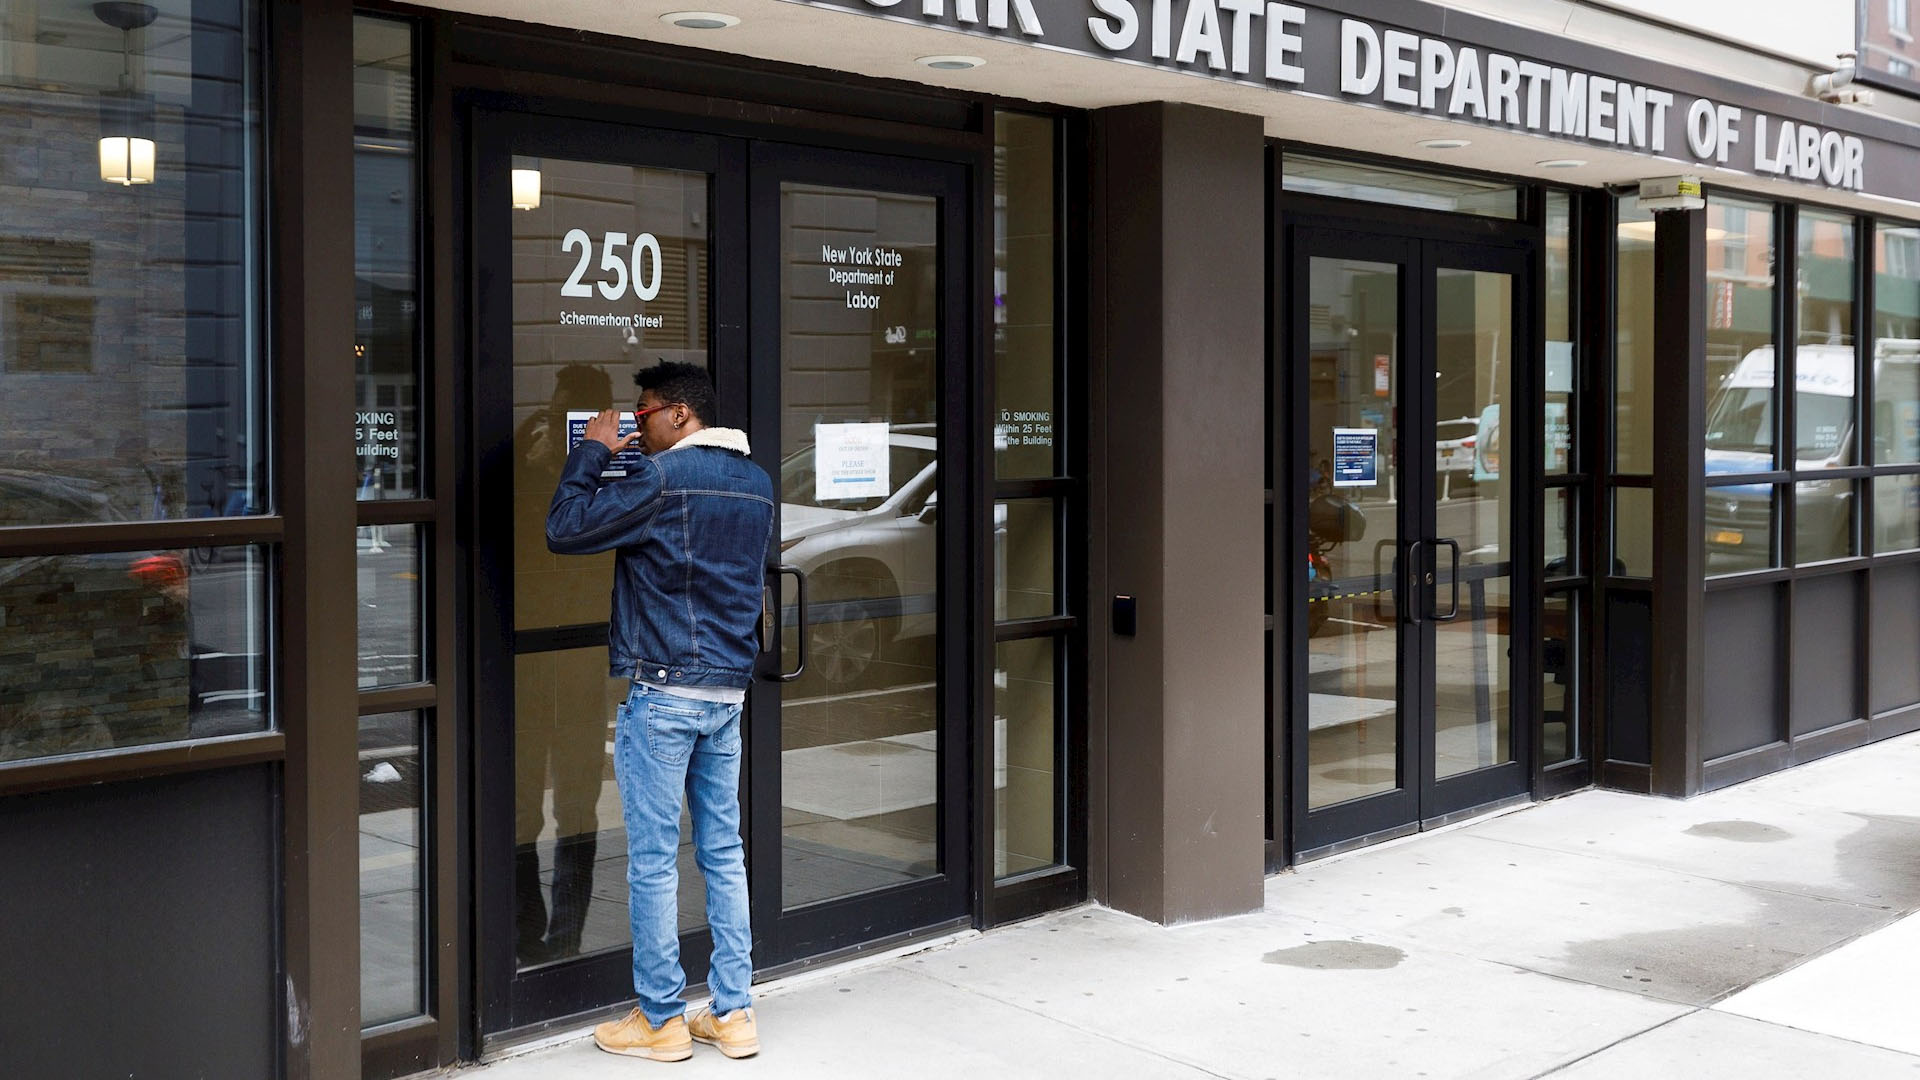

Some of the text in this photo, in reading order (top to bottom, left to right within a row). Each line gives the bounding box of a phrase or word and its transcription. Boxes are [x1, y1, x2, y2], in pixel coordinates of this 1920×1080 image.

[1087, 0, 1305, 84] STATE
[1340, 18, 1674, 152] DEPARTMENT
[1687, 98, 1741, 163] OF
[1754, 114, 1864, 190] LABOR
[822, 245, 902, 267] New York State
[560, 228, 662, 301] 250
[829, 267, 894, 287] Department of
[846, 290, 880, 309] Labor
[560, 311, 663, 328] Schermerhorn Street
[355, 412, 394, 425] OKING
[1013, 411, 1050, 421] SMOKING
[355, 428, 399, 440] 5 Feet
[995, 424, 1053, 433] Within 25 Feet
[1007, 436, 1020, 445] the
[1022, 436, 1053, 446] Building
[356, 444, 399, 458] uilding
